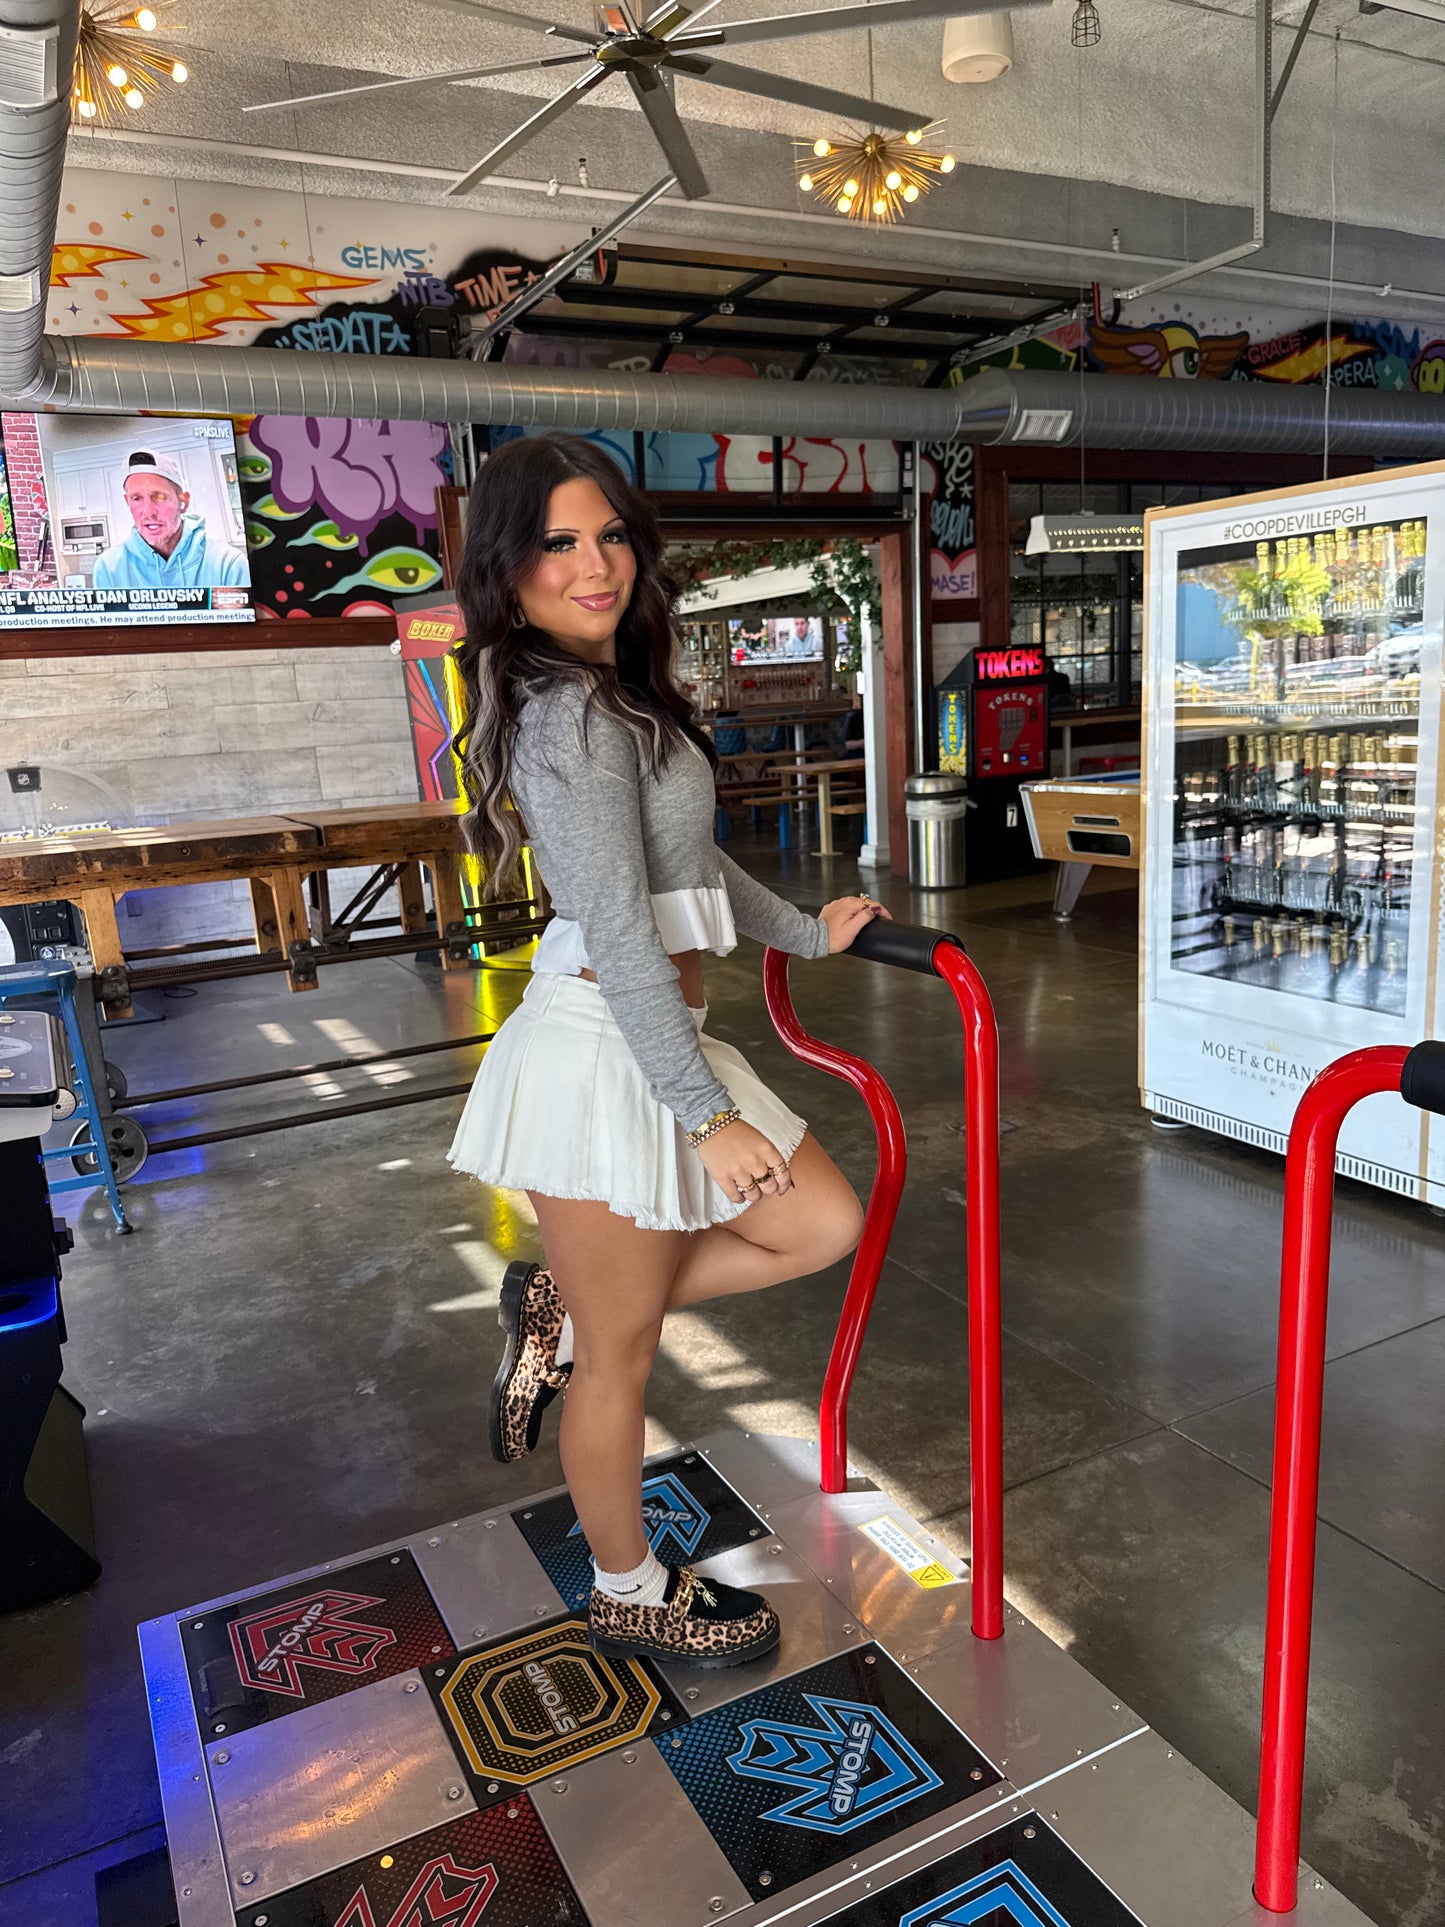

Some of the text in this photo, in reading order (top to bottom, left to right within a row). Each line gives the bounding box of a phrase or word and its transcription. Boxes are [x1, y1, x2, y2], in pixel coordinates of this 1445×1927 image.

[1248, 332, 1302, 364] GRACE
[1223, 505, 1367, 540] #COOPDEVILLEPGH
[27, 590, 94, 605] ANALYST
[96, 589, 128, 604] DAN
[129, 588, 205, 603] ORLOVSKY
[216, 592, 249, 605] ESPN
[51, 616, 98, 626] meetings.
[99, 615, 113, 624] He
[114, 615, 133, 625] may
[136, 614, 165, 623] attend
[168, 612, 215, 623] production
[408, 620, 455, 641] BOXER
[975, 649, 1045, 680] TOKENS
[988, 692, 1034, 711] TOKENS
[948, 693, 957, 754] TOKENS
[1008, 808, 1016, 826] 7
[1201, 1040, 1319, 1082] MOËT & CHAN
[1230, 1066, 1303, 1091] CHAMPAG
[257, 1602, 324, 1673] STOMP
[525, 1662, 578, 1733] STOMP
[831, 1720, 873, 1814] STOMP
